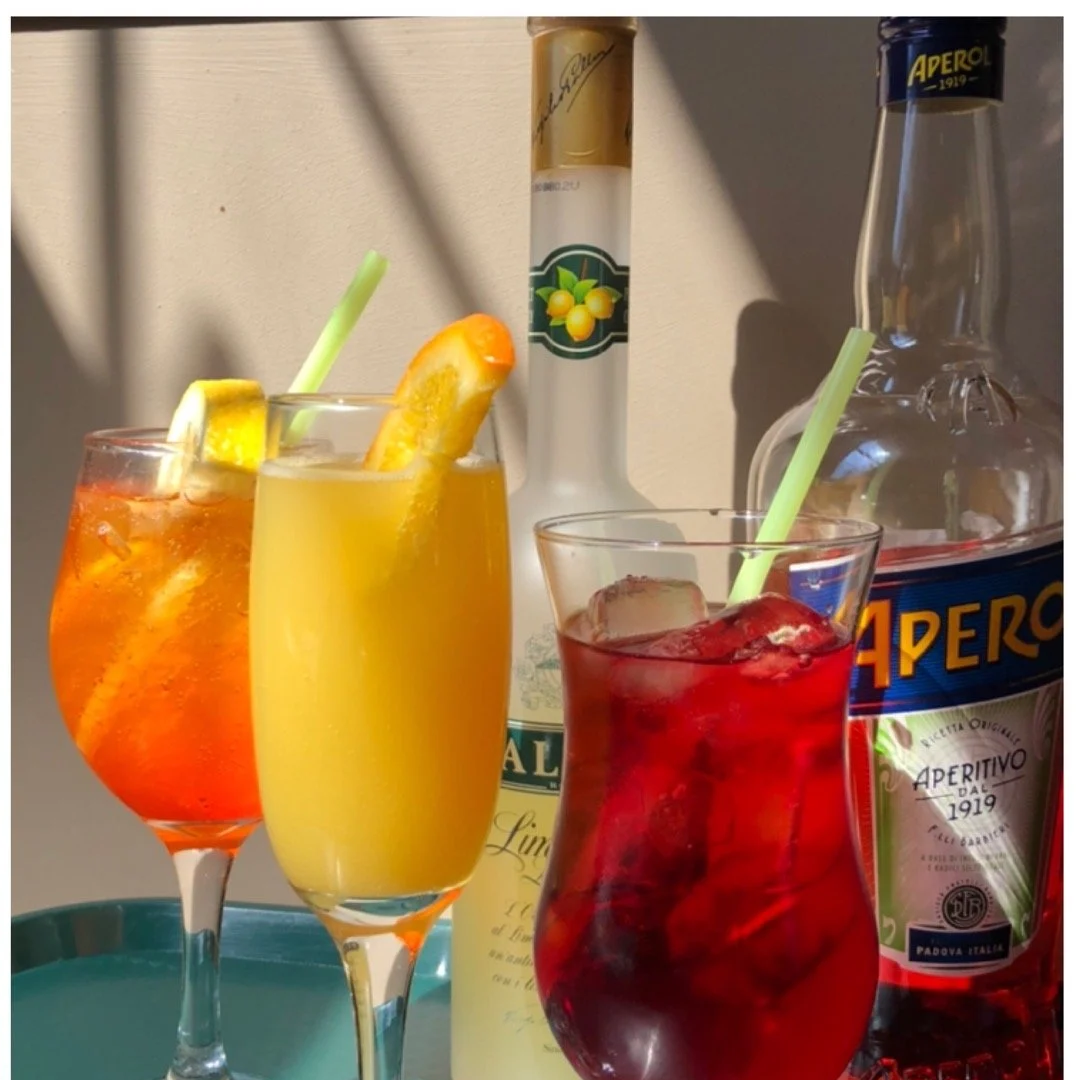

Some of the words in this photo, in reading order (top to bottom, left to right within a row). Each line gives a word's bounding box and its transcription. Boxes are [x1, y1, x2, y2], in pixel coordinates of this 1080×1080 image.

[907, 45, 992, 87] APEROL
[939, 75, 966, 90] 1919
[920, 722, 964, 748] RICETTA
[969, 717, 1020, 745] ORIGINALE
[912, 748, 1027, 790] APERITIVO
[958, 784, 988, 797] DAL
[948, 794, 997, 821] 1919
[916, 945, 963, 956] PADOVA
[968, 944, 1004, 955] ITALIA
